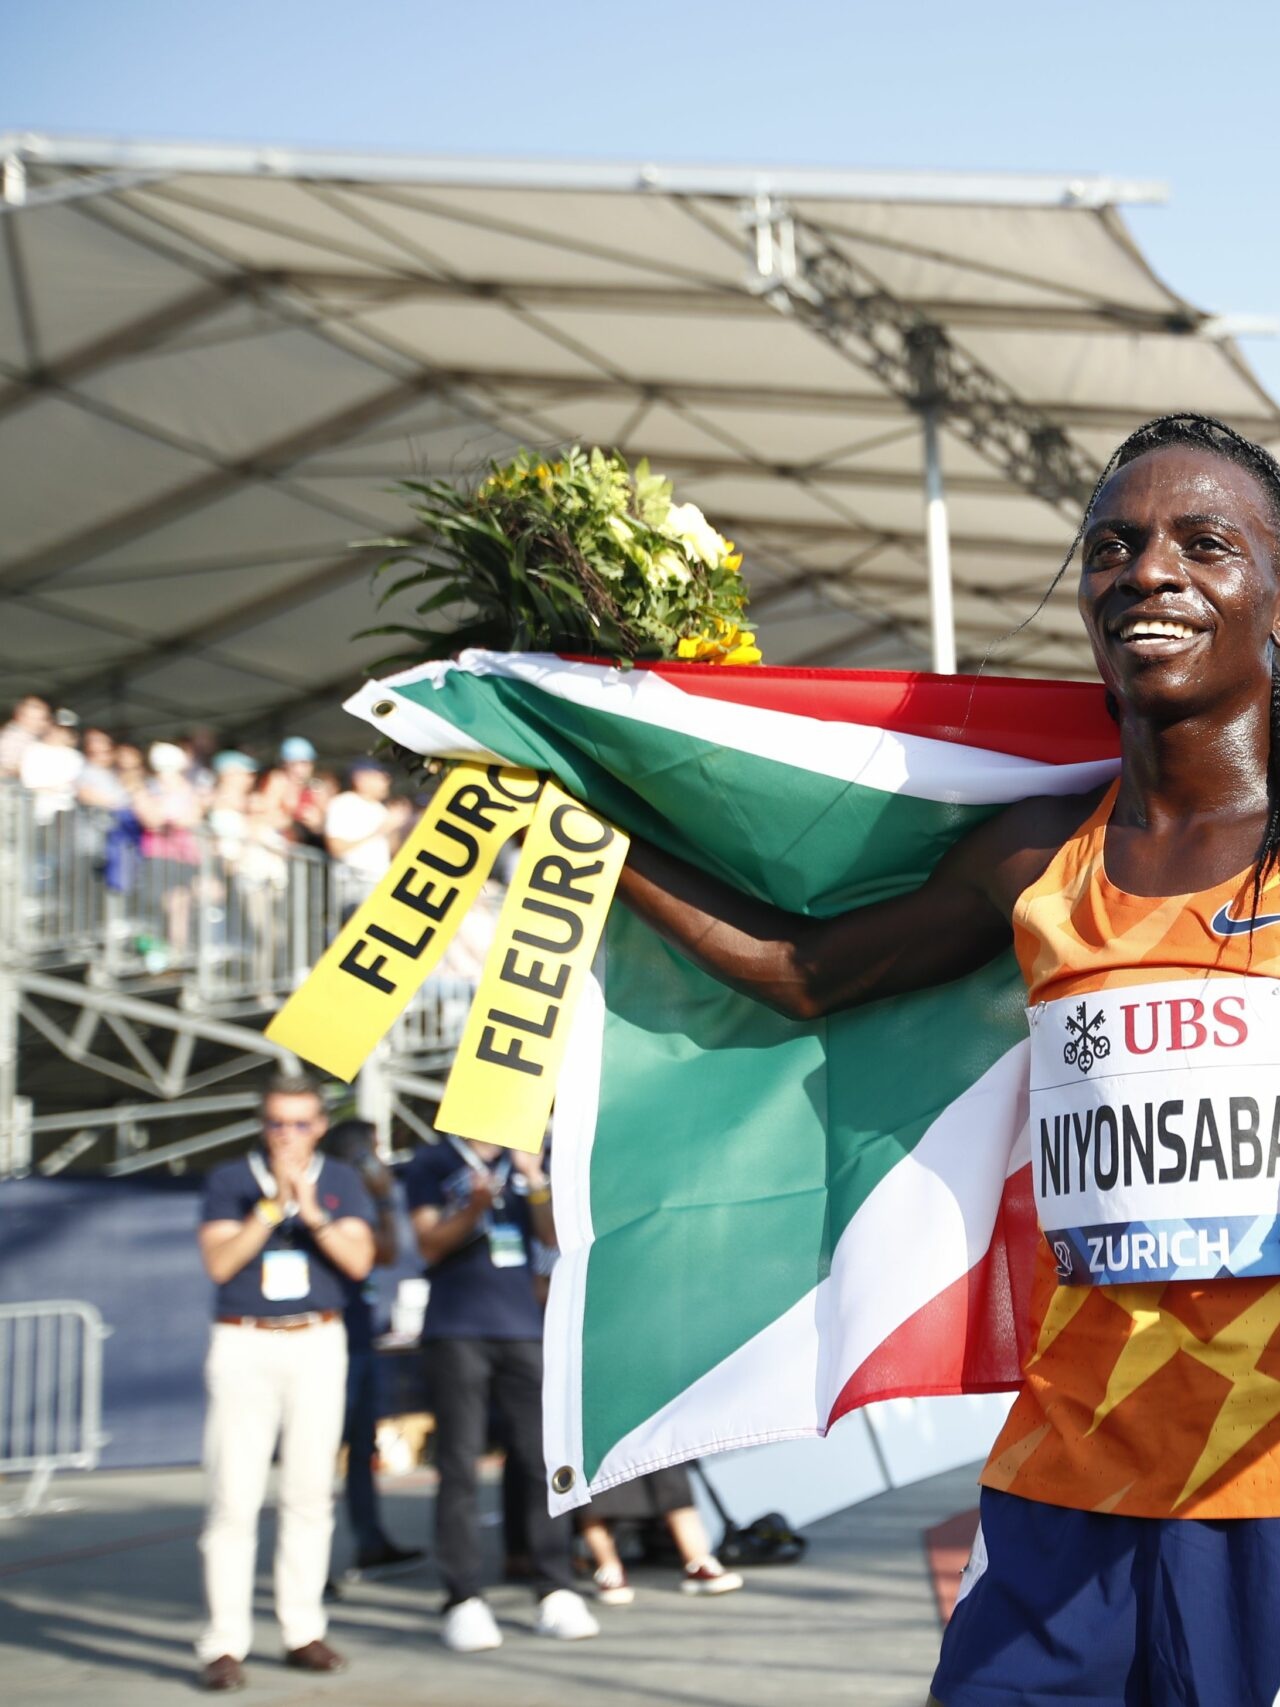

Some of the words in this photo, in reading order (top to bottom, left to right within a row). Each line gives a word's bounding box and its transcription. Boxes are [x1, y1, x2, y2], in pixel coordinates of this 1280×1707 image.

[339, 765, 549, 995] FLEURO
[476, 804, 615, 1077] FLEURO
[1120, 996, 1249, 1055] UBS
[1087, 1228, 1231, 1273] ZURICH
